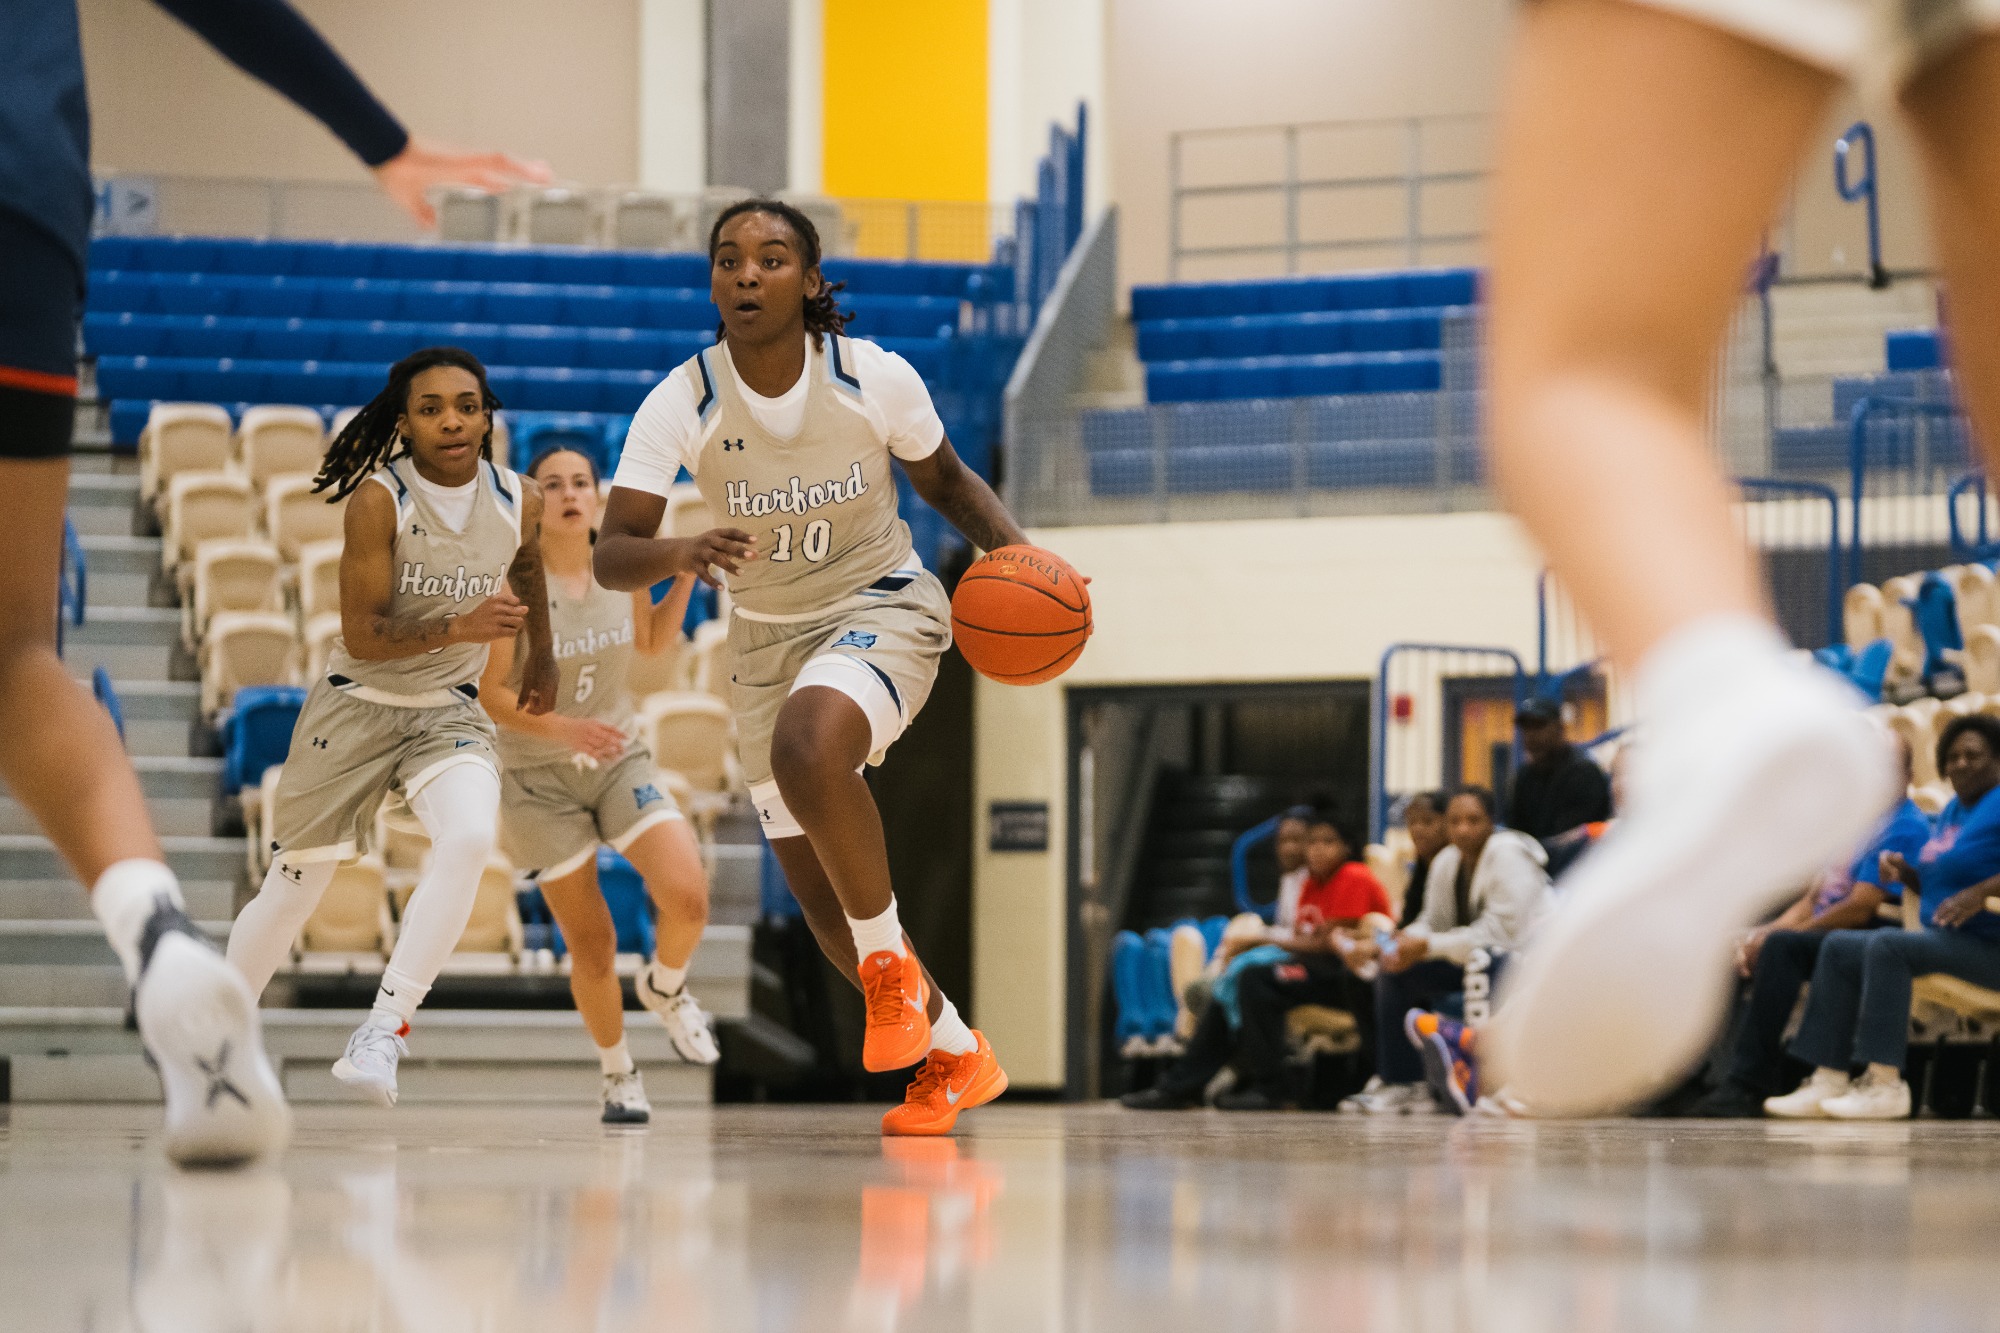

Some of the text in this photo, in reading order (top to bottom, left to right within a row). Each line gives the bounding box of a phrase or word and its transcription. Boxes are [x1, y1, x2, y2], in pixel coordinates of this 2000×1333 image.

[726, 461, 869, 517] Harford
[770, 518, 832, 563] 10
[575, 664, 598, 703] 5
